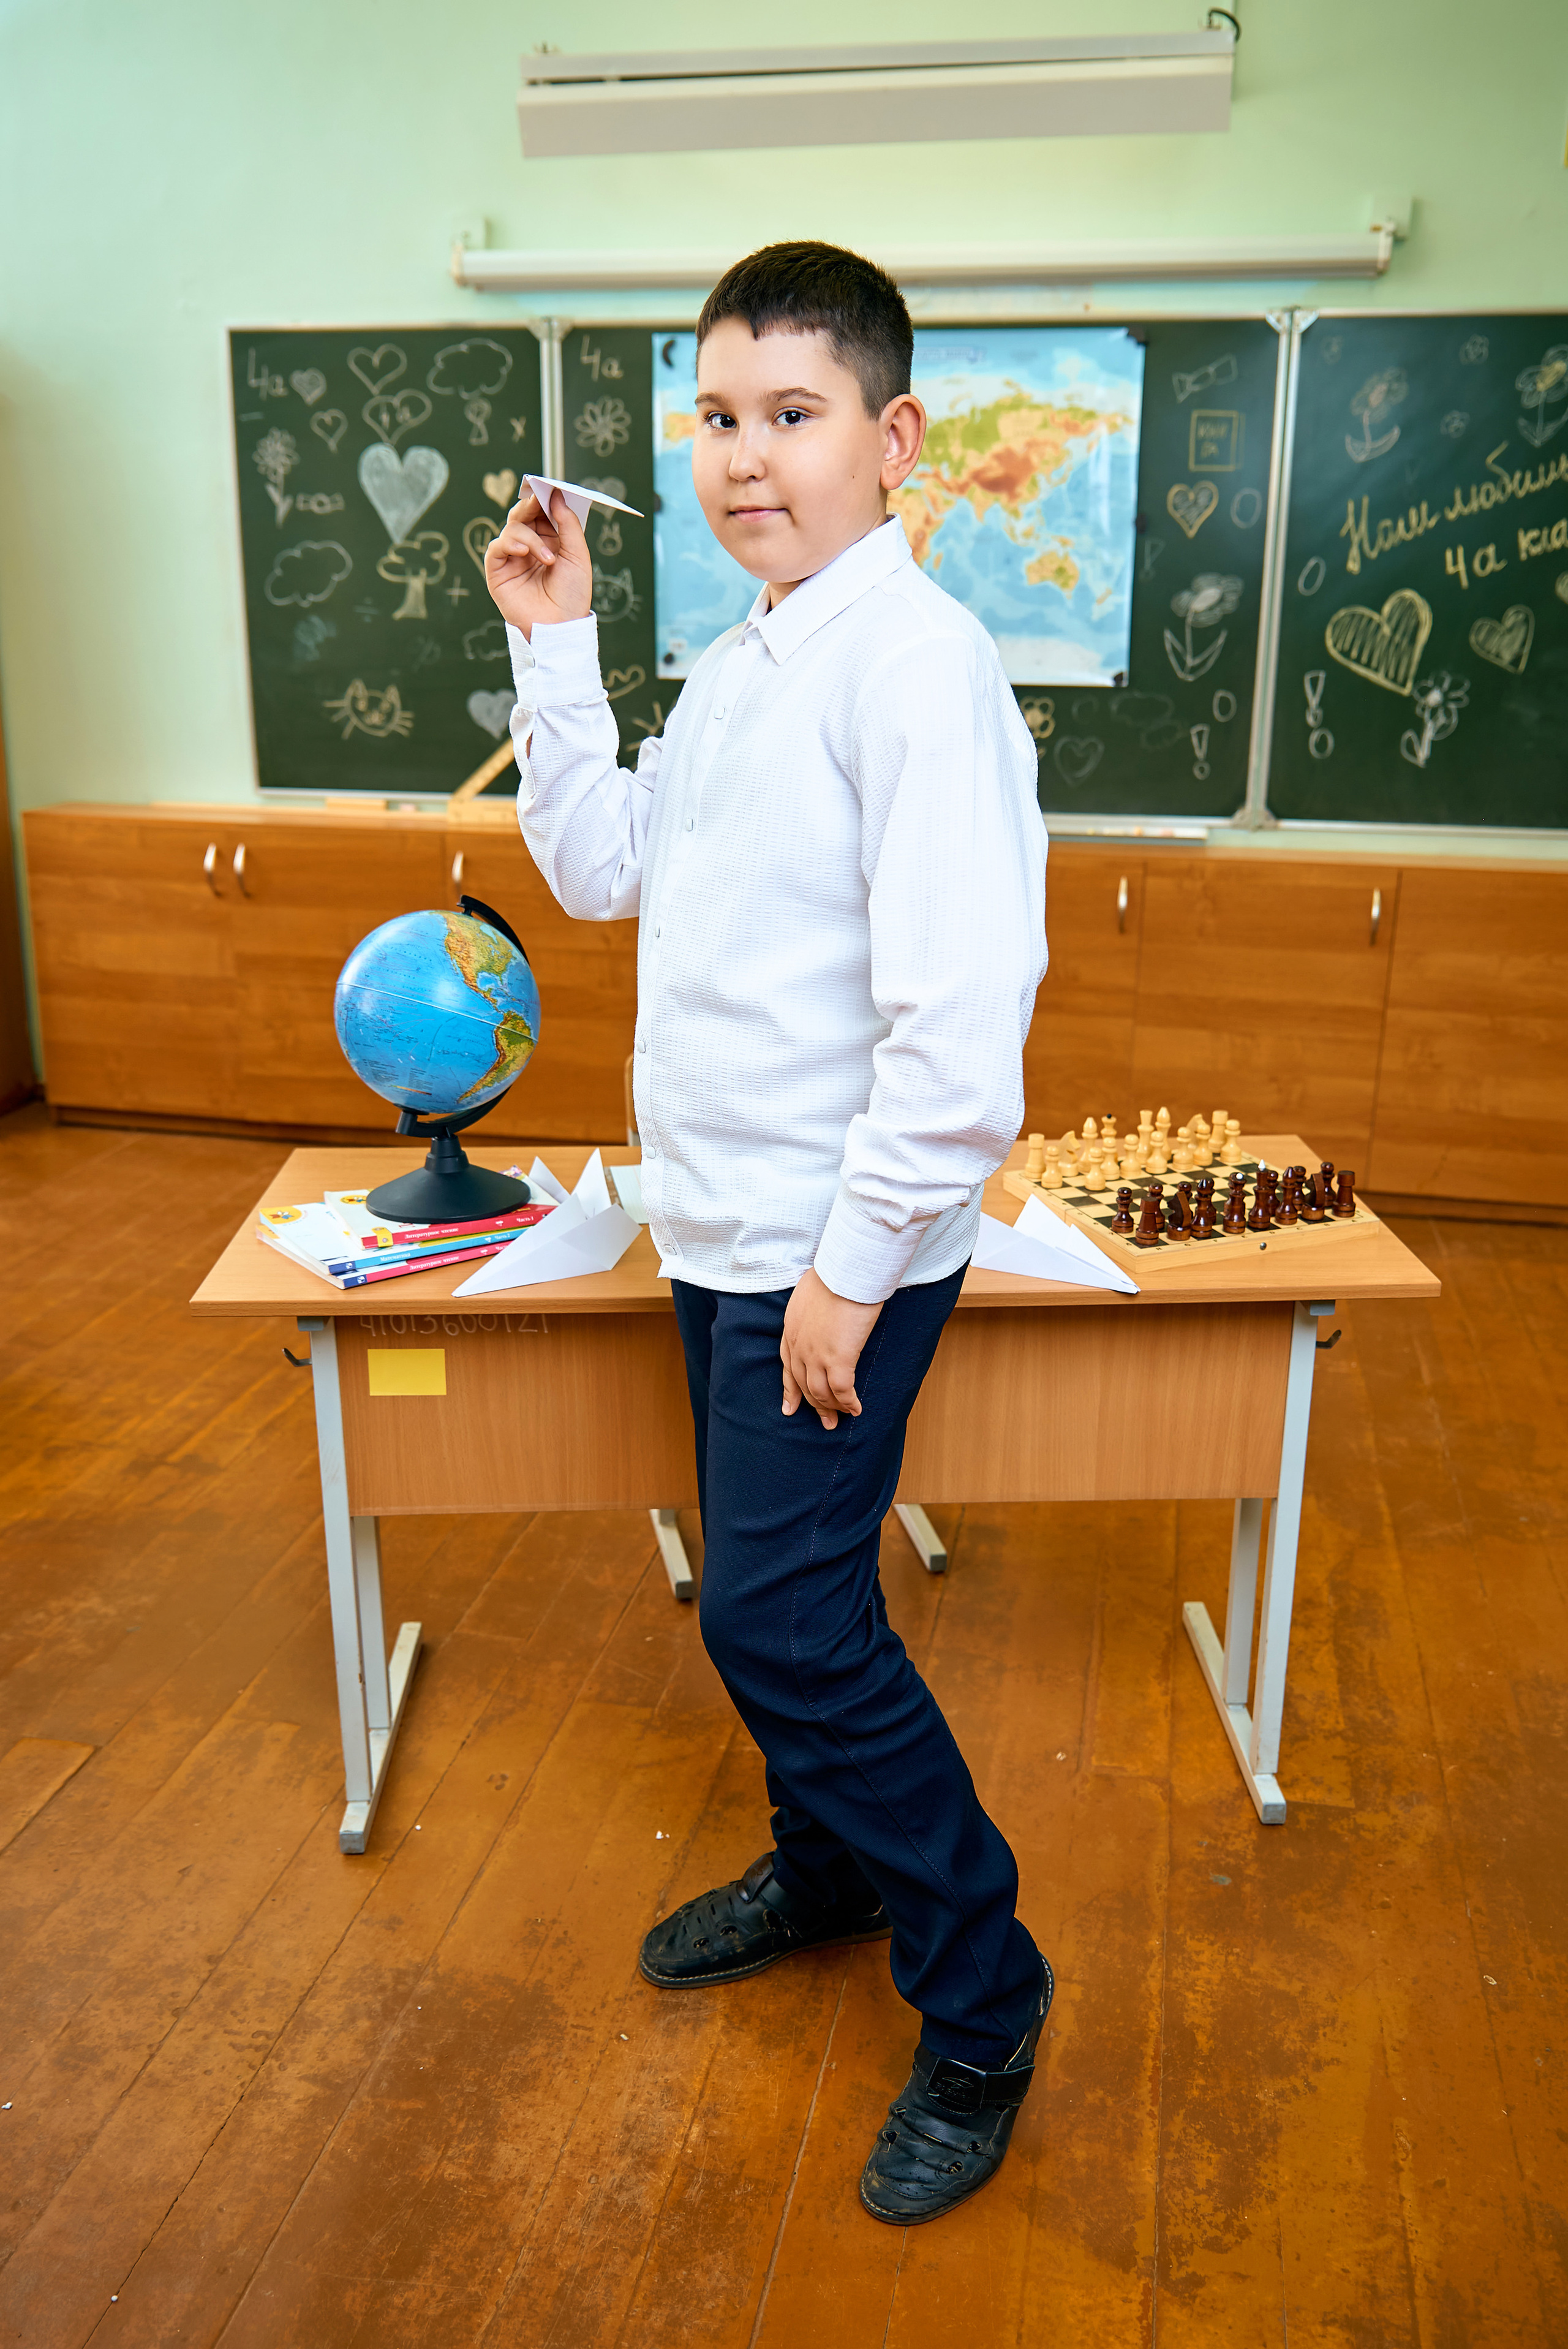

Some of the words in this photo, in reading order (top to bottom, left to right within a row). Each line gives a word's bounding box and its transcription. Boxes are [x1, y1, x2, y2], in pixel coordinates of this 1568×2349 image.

[1340, 494, 1441, 575] Наш
[1445, 543, 1509, 589] 4а
[405, 1230, 440, 1239] Литературное
[380, 1252, 411, 1262] Математика
[409, 1260, 442, 1271] Литературное
